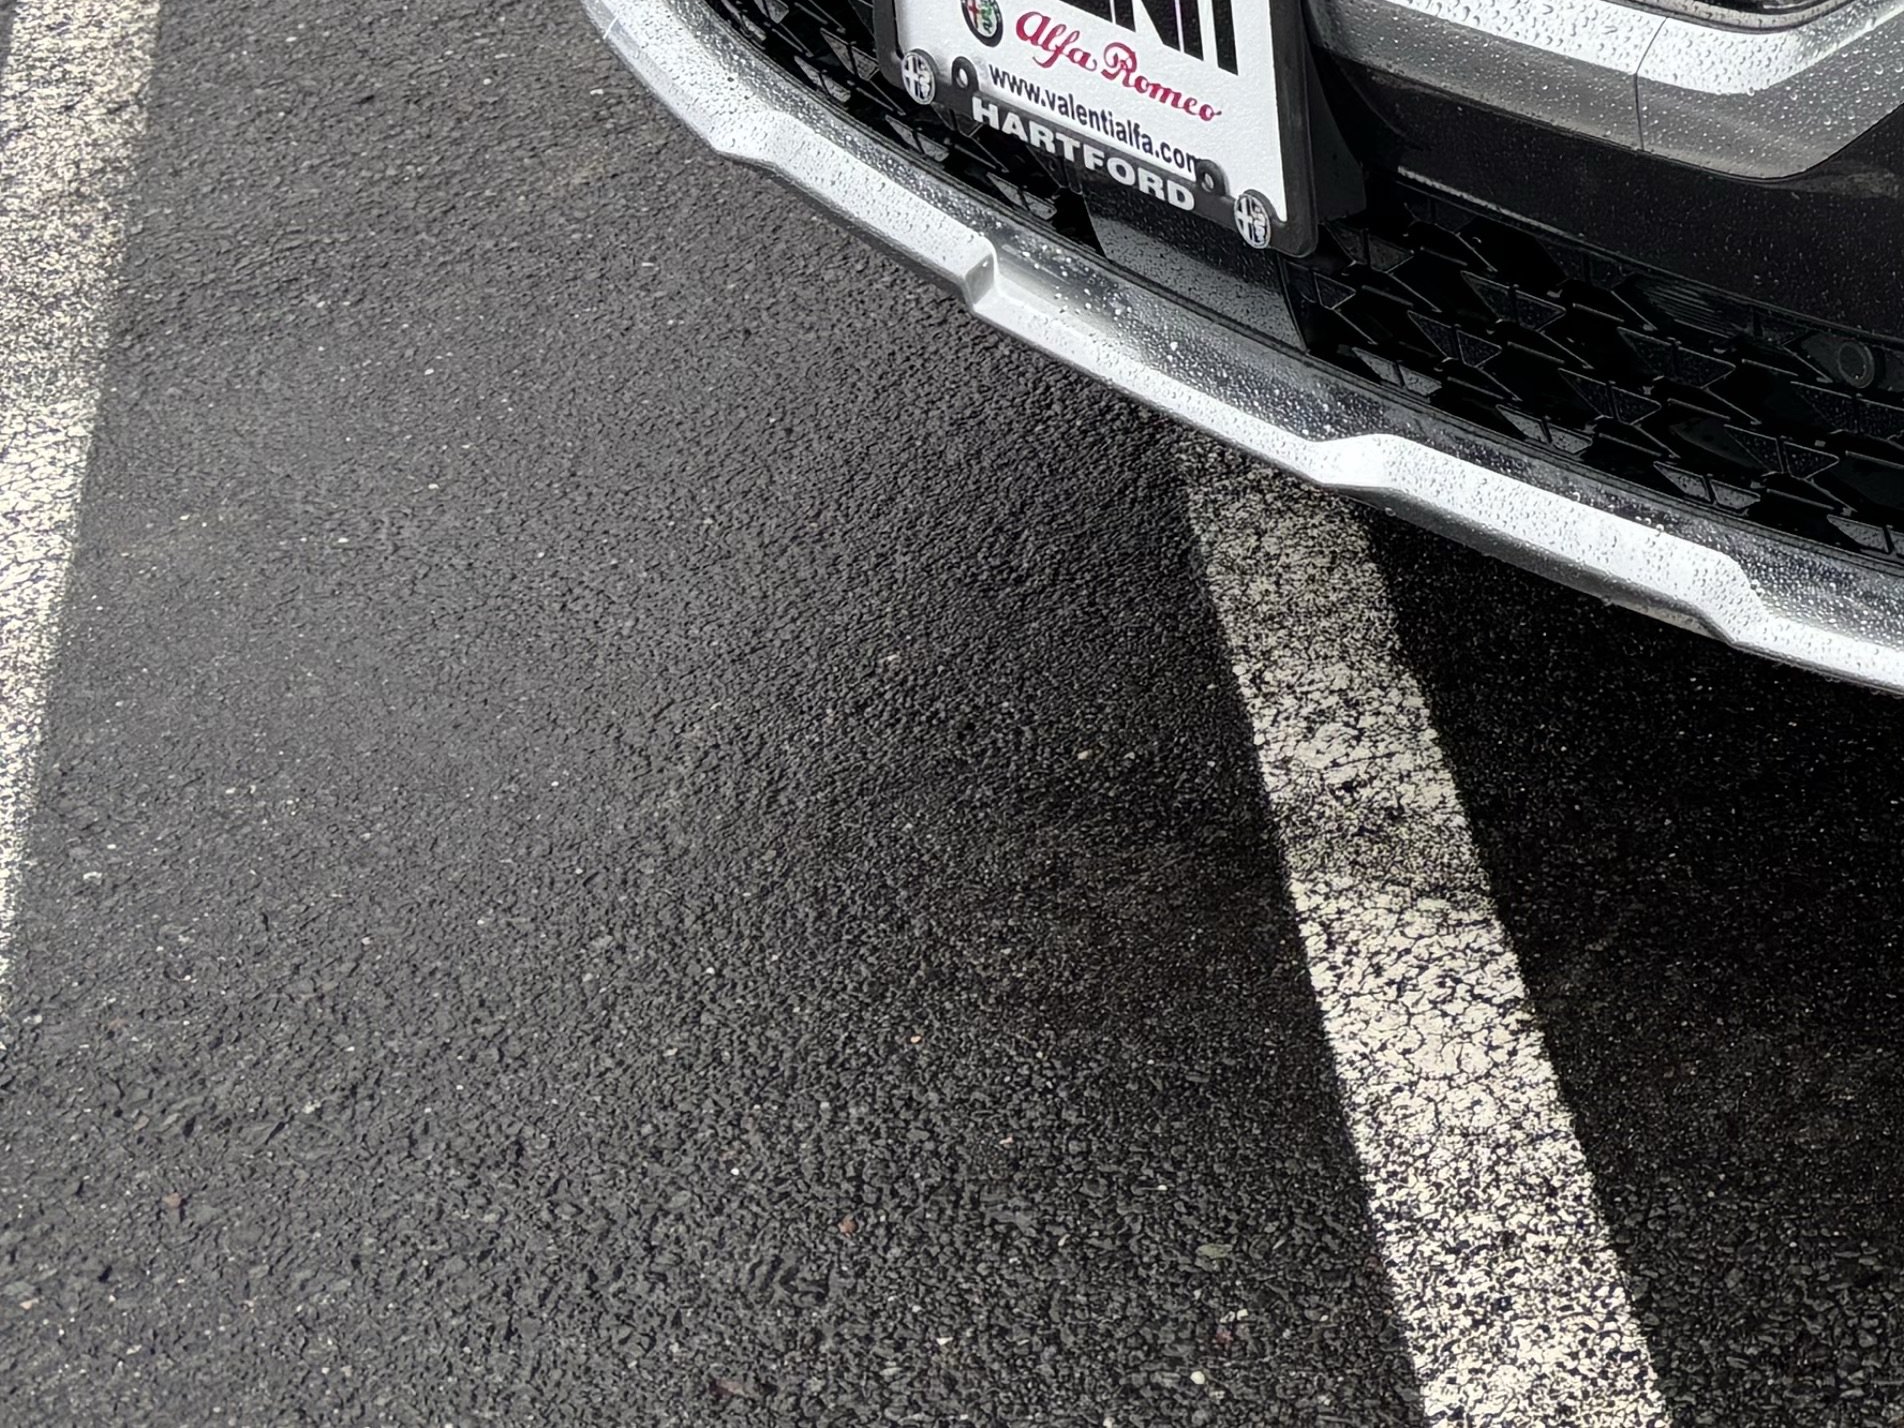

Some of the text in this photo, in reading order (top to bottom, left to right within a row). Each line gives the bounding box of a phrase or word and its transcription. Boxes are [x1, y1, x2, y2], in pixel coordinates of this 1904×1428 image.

[1015, 10, 1222, 122] Alfa Romeo
[972, 97, 1195, 211] HARTFORD
